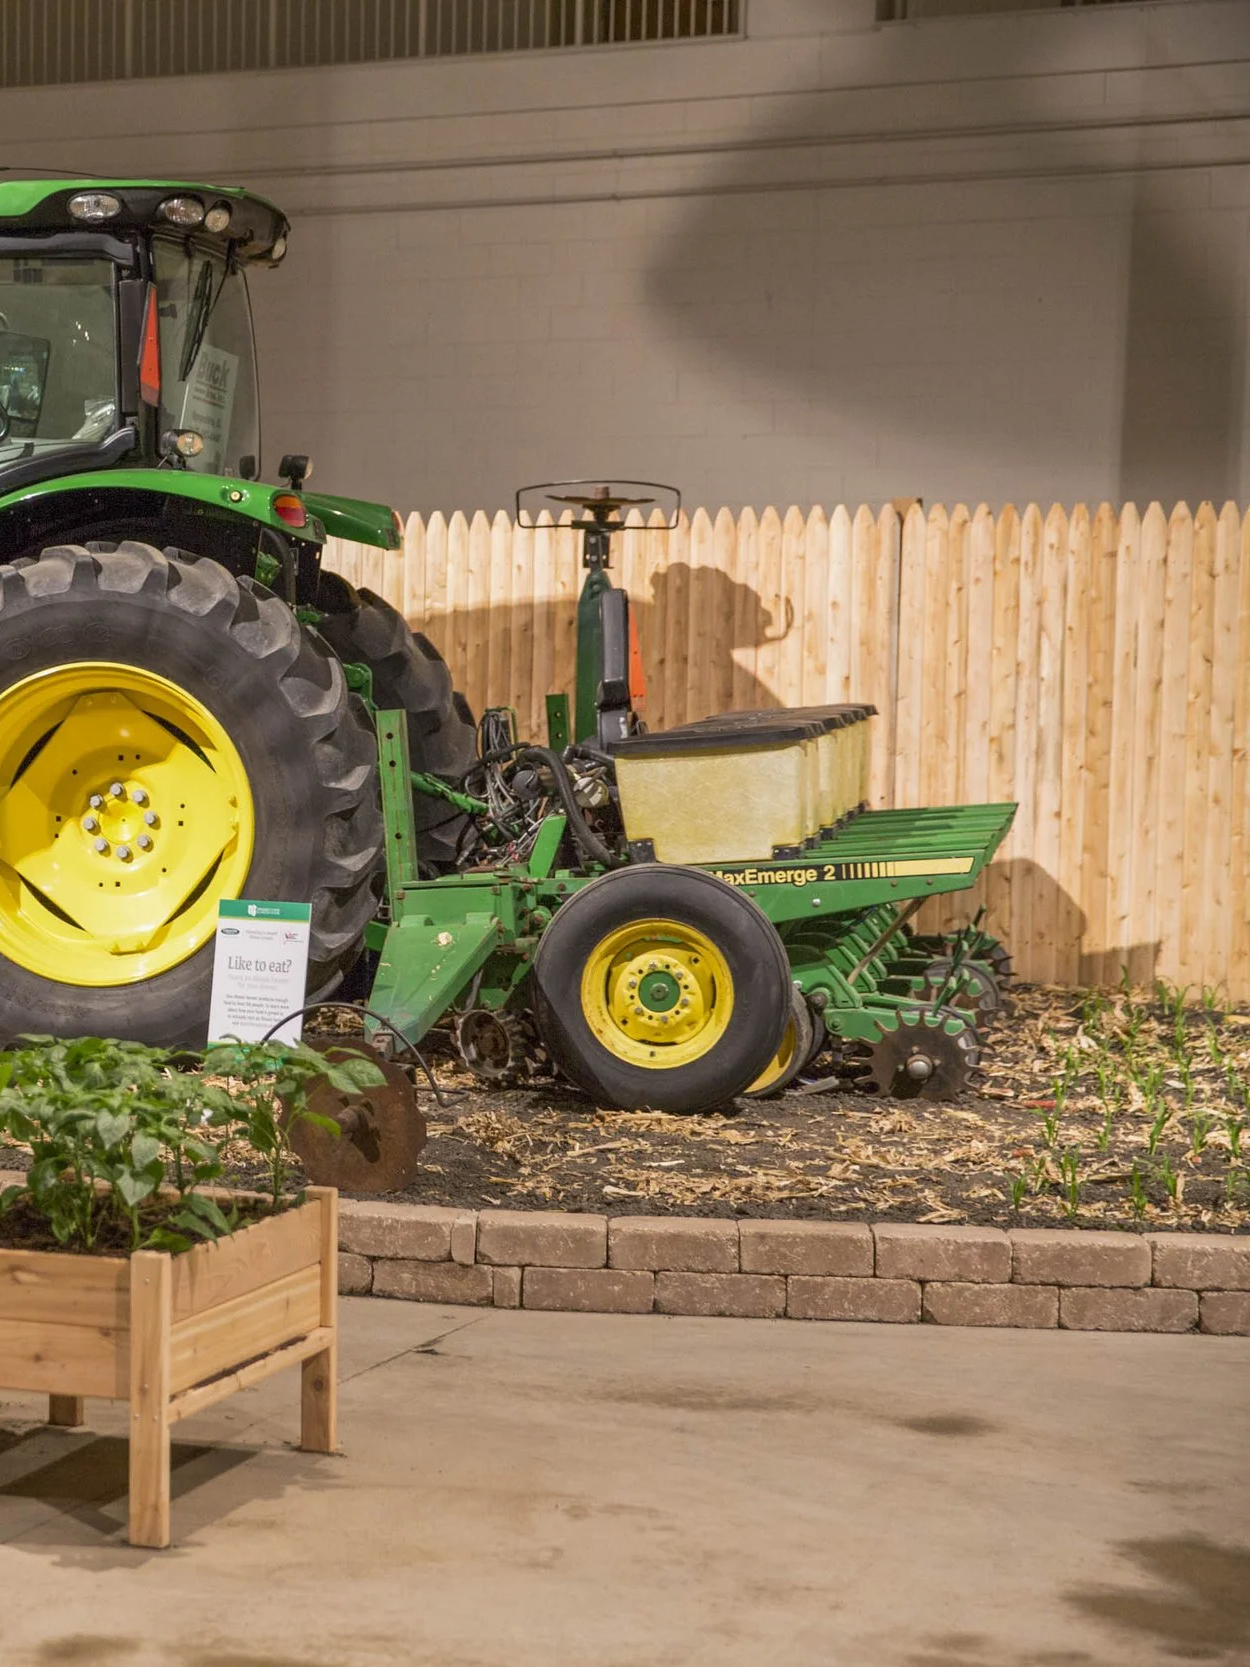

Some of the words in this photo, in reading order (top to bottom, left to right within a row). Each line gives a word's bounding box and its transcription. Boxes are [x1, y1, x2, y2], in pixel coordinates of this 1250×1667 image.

[823, 864, 836, 880] 2
[228, 956, 252, 971] Like
[255, 960, 267, 972] to
[268, 959, 292, 974] eat?
